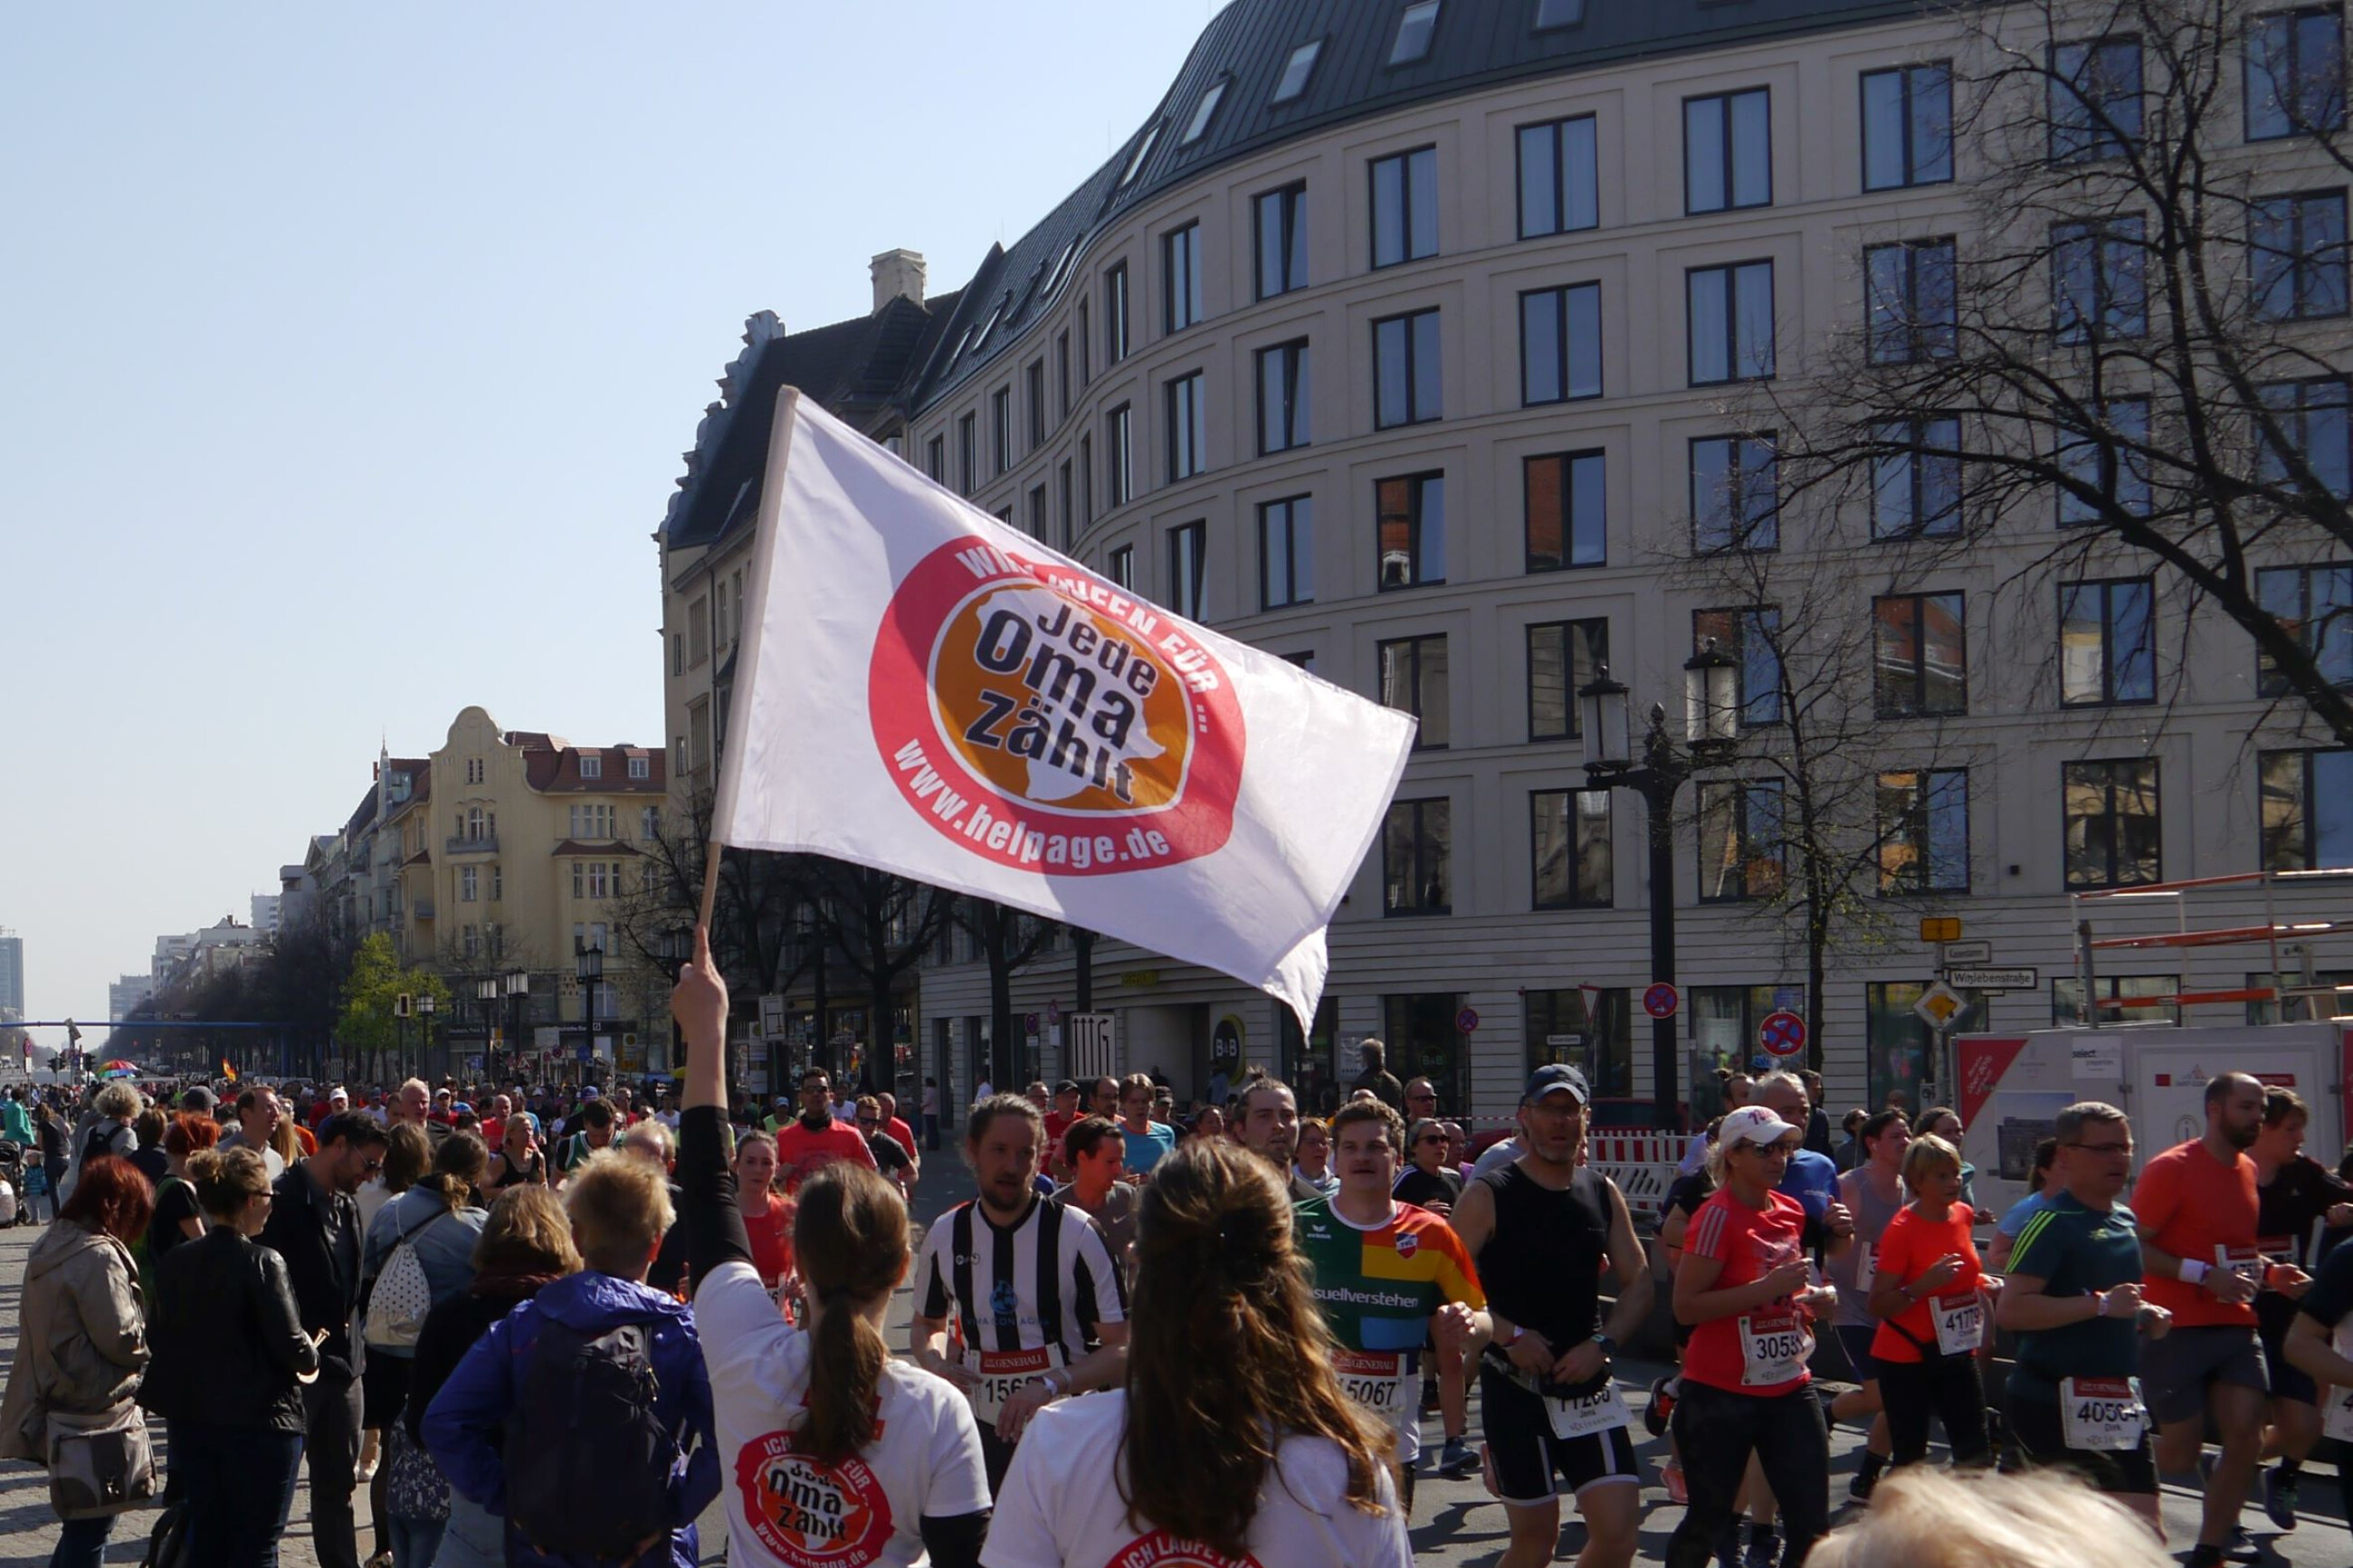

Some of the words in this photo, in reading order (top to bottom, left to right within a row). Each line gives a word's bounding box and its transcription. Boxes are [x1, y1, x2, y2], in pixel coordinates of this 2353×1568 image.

[976, 610, 1136, 750] Oma
[1037, 604, 1157, 697] Jede
[1159, 633, 1219, 693] FÜR
[964, 689, 1135, 803] Zählt
[893, 738, 1170, 869] www.helpage.de
[996, 1355, 1043, 1369] GENERALI
[843, 1459, 872, 1489] FÜR
